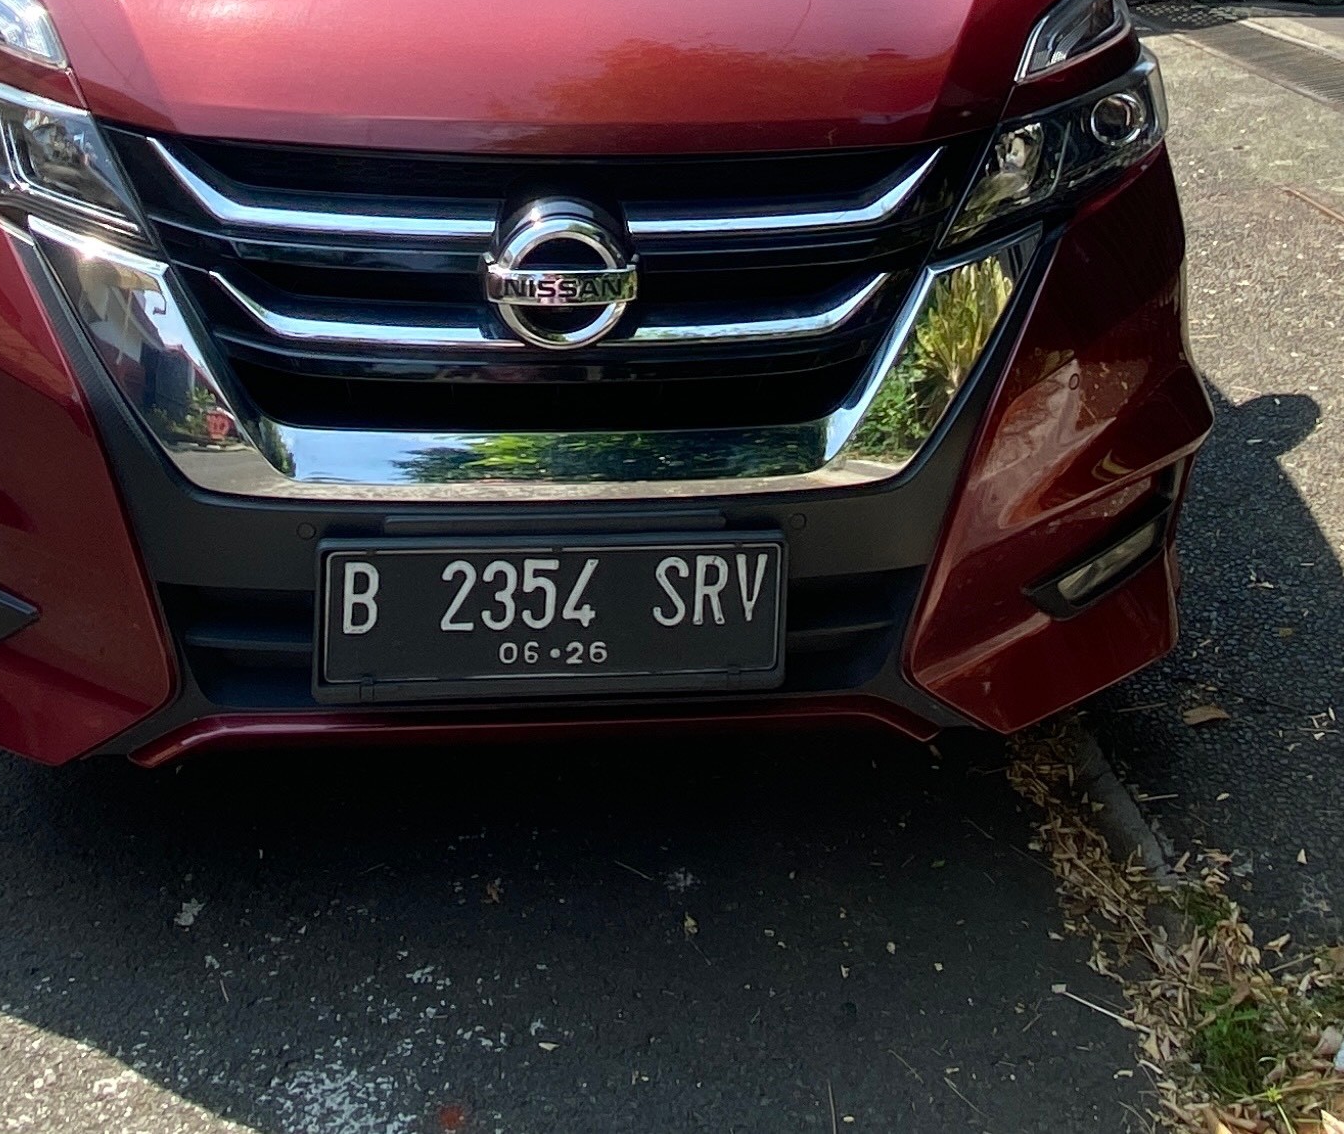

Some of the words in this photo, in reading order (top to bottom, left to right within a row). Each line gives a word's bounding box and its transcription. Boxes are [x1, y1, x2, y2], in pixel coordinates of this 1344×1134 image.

[504, 279, 622, 298] NISSAN
[343, 562, 380, 634] B
[440, 559, 599, 631] 2354
[653, 553, 768, 626] SRV
